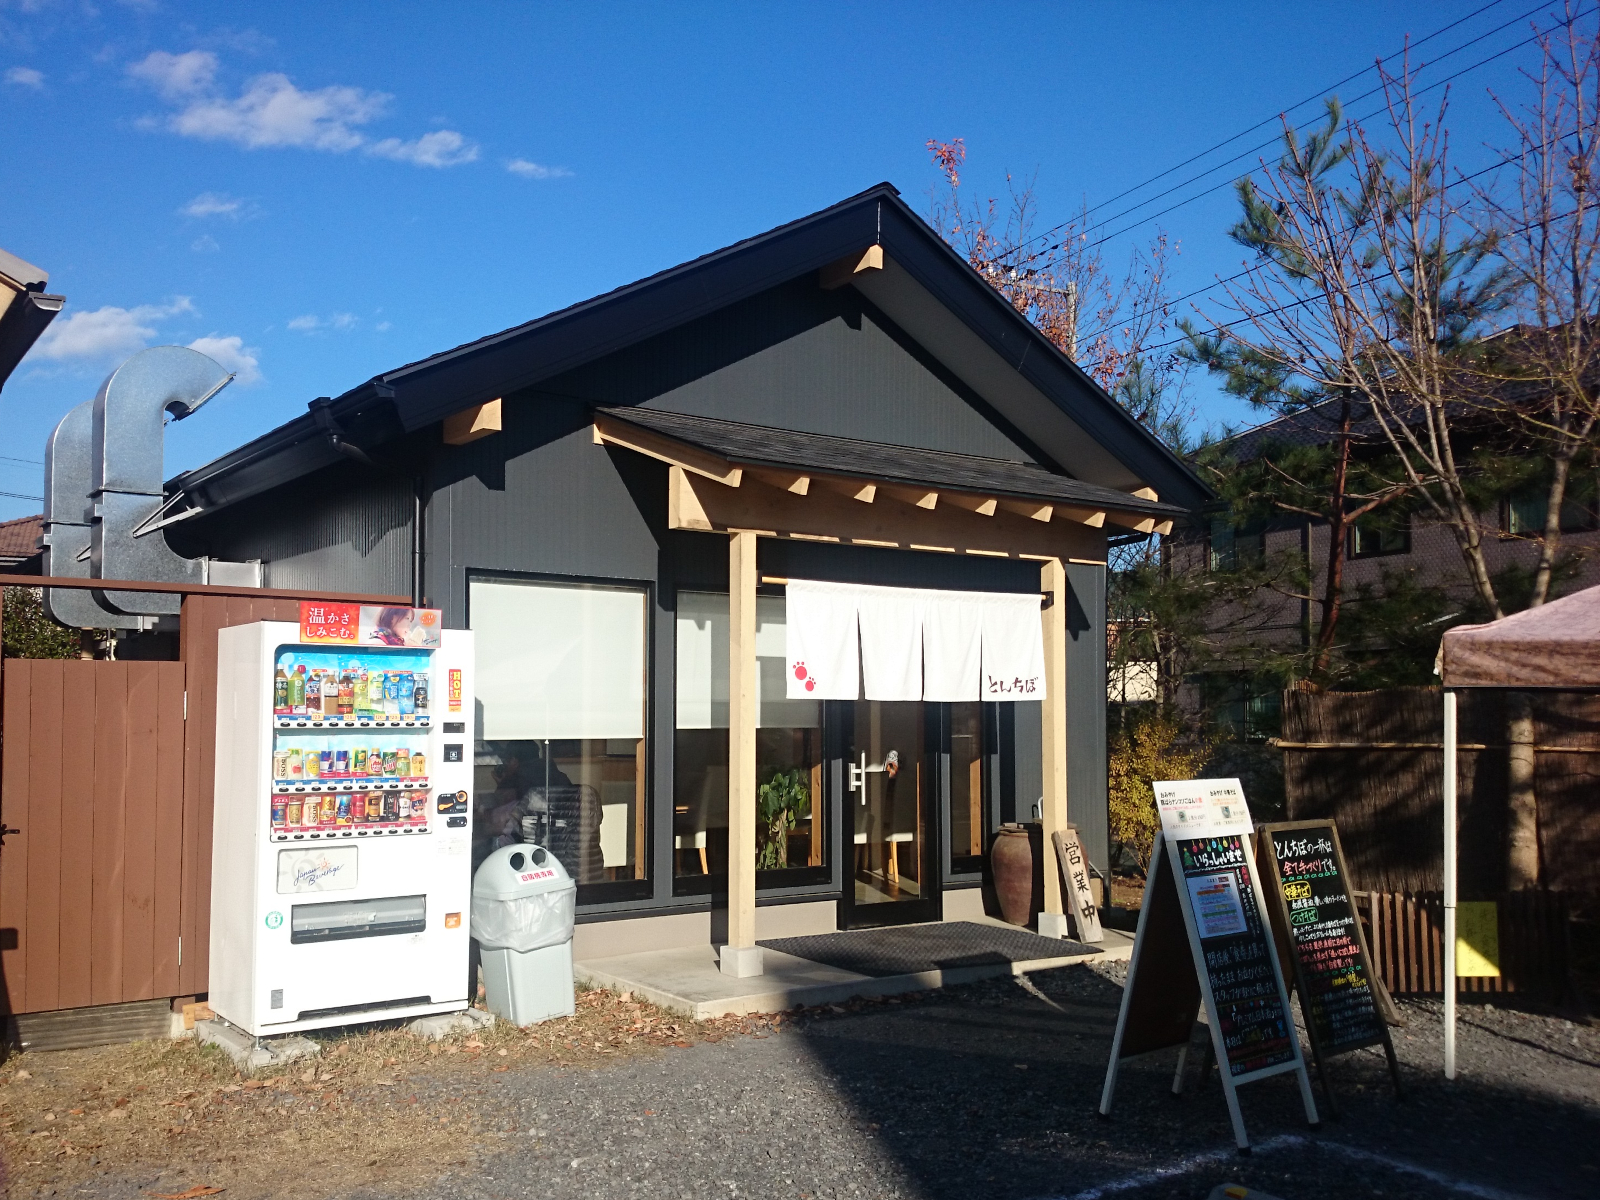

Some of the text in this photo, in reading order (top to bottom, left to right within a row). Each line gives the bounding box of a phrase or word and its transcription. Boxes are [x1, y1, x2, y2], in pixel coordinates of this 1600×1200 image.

[309, 607, 350, 624] 温かさ
[306, 626, 354, 639] しみこむ。
[453, 671, 461, 698] HOT
[988, 674, 1039, 693] とんちぼ
[1273, 838, 1333, 859] とんちぼの一杯は
[1193, 849, 1243, 867] いらっしゃいませ
[1064, 842, 1097, 926] 営業中
[1284, 884, 1311, 899] 中華そば
